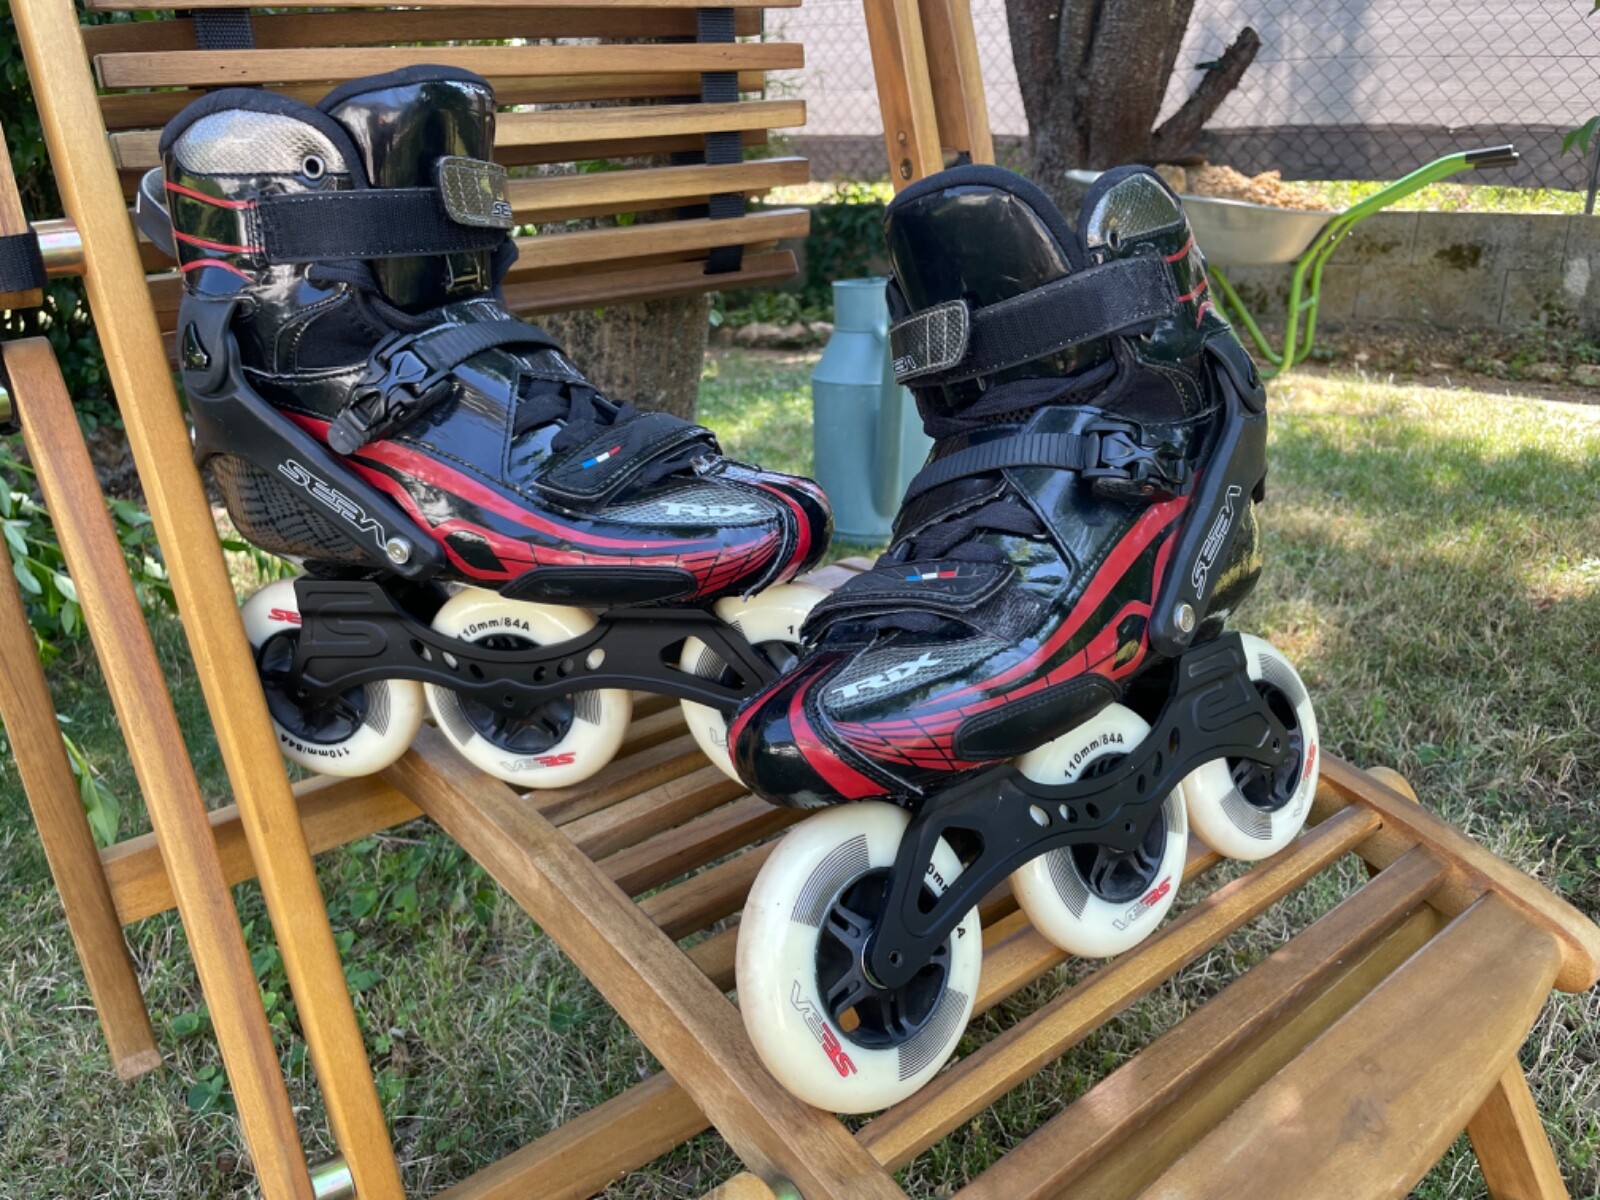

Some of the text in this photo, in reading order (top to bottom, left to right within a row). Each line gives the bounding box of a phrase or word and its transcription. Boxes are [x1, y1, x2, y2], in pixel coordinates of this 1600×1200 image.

[278, 459, 387, 550] SEBA
[268, 607, 302, 625] SE
[458, 617, 530, 642] 10mm/84A
[1064, 733, 1124, 779] 110mm/84A
[1113, 876, 1171, 931] SEBA
[790, 980, 858, 1078] SEBA
